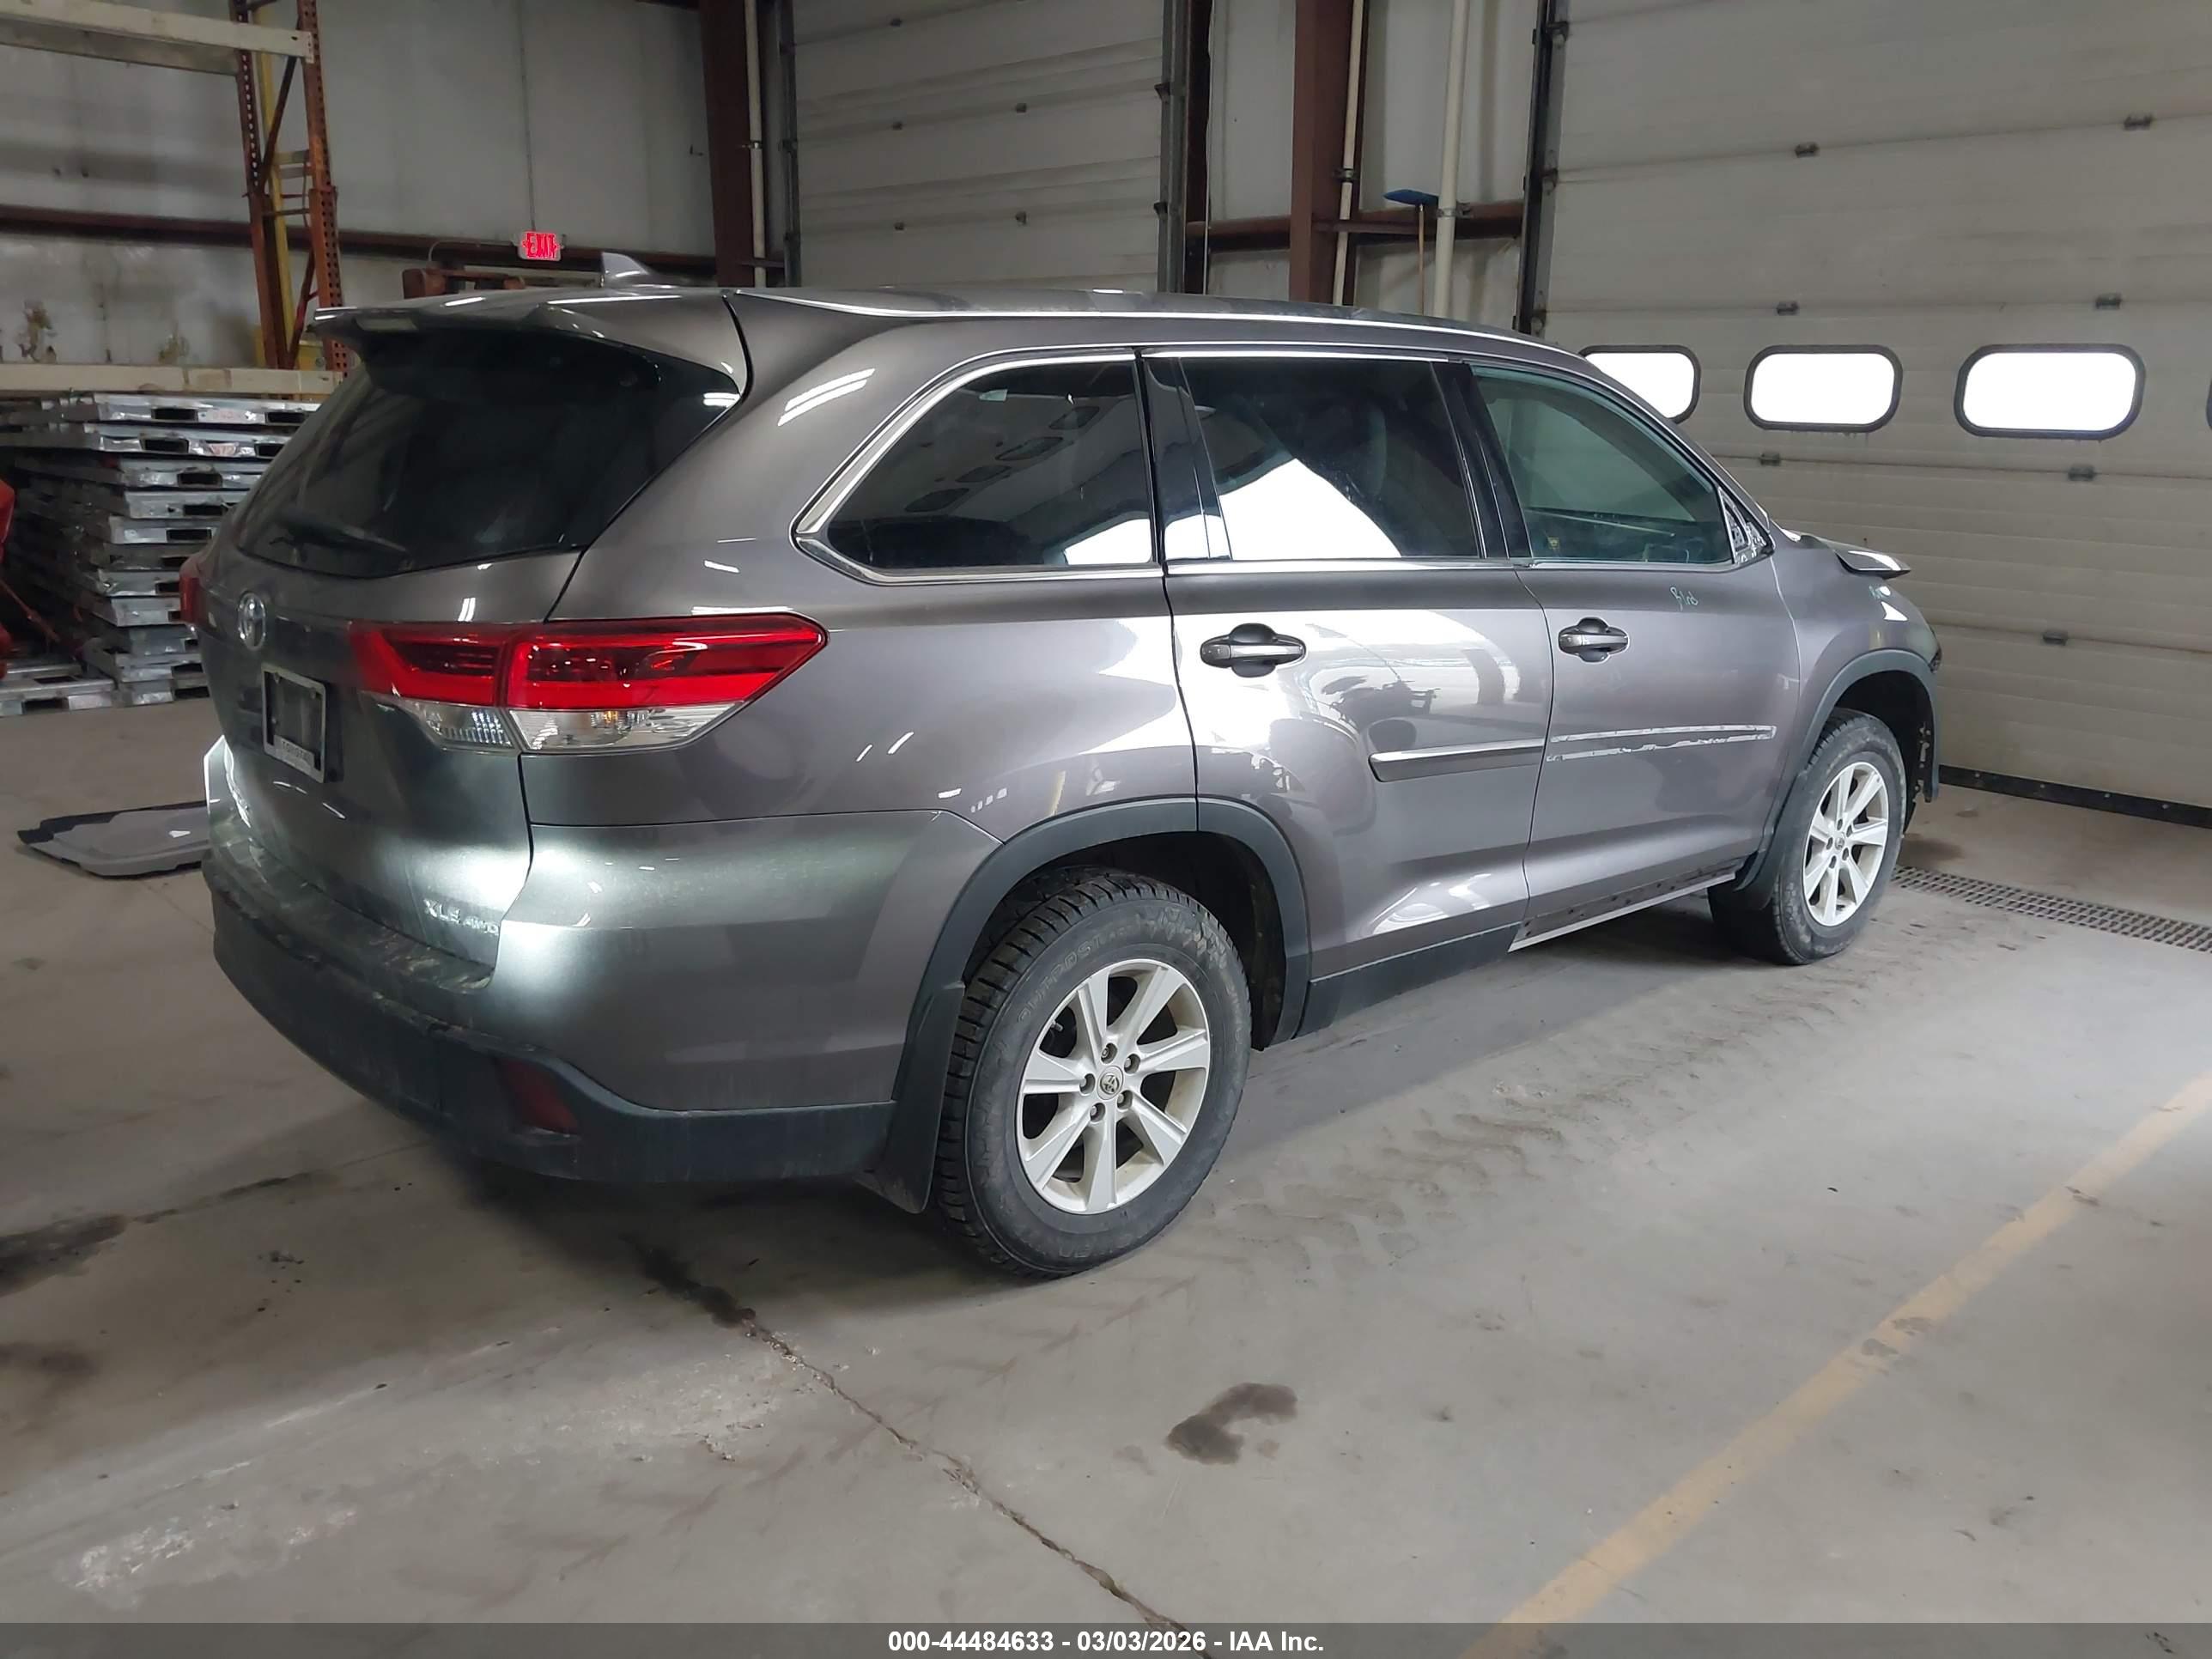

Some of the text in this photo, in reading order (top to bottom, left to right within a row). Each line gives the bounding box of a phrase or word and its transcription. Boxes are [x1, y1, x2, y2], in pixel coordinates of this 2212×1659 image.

[526, 233, 556, 258] EXIT
[424, 900, 499, 936] XLE AWD
